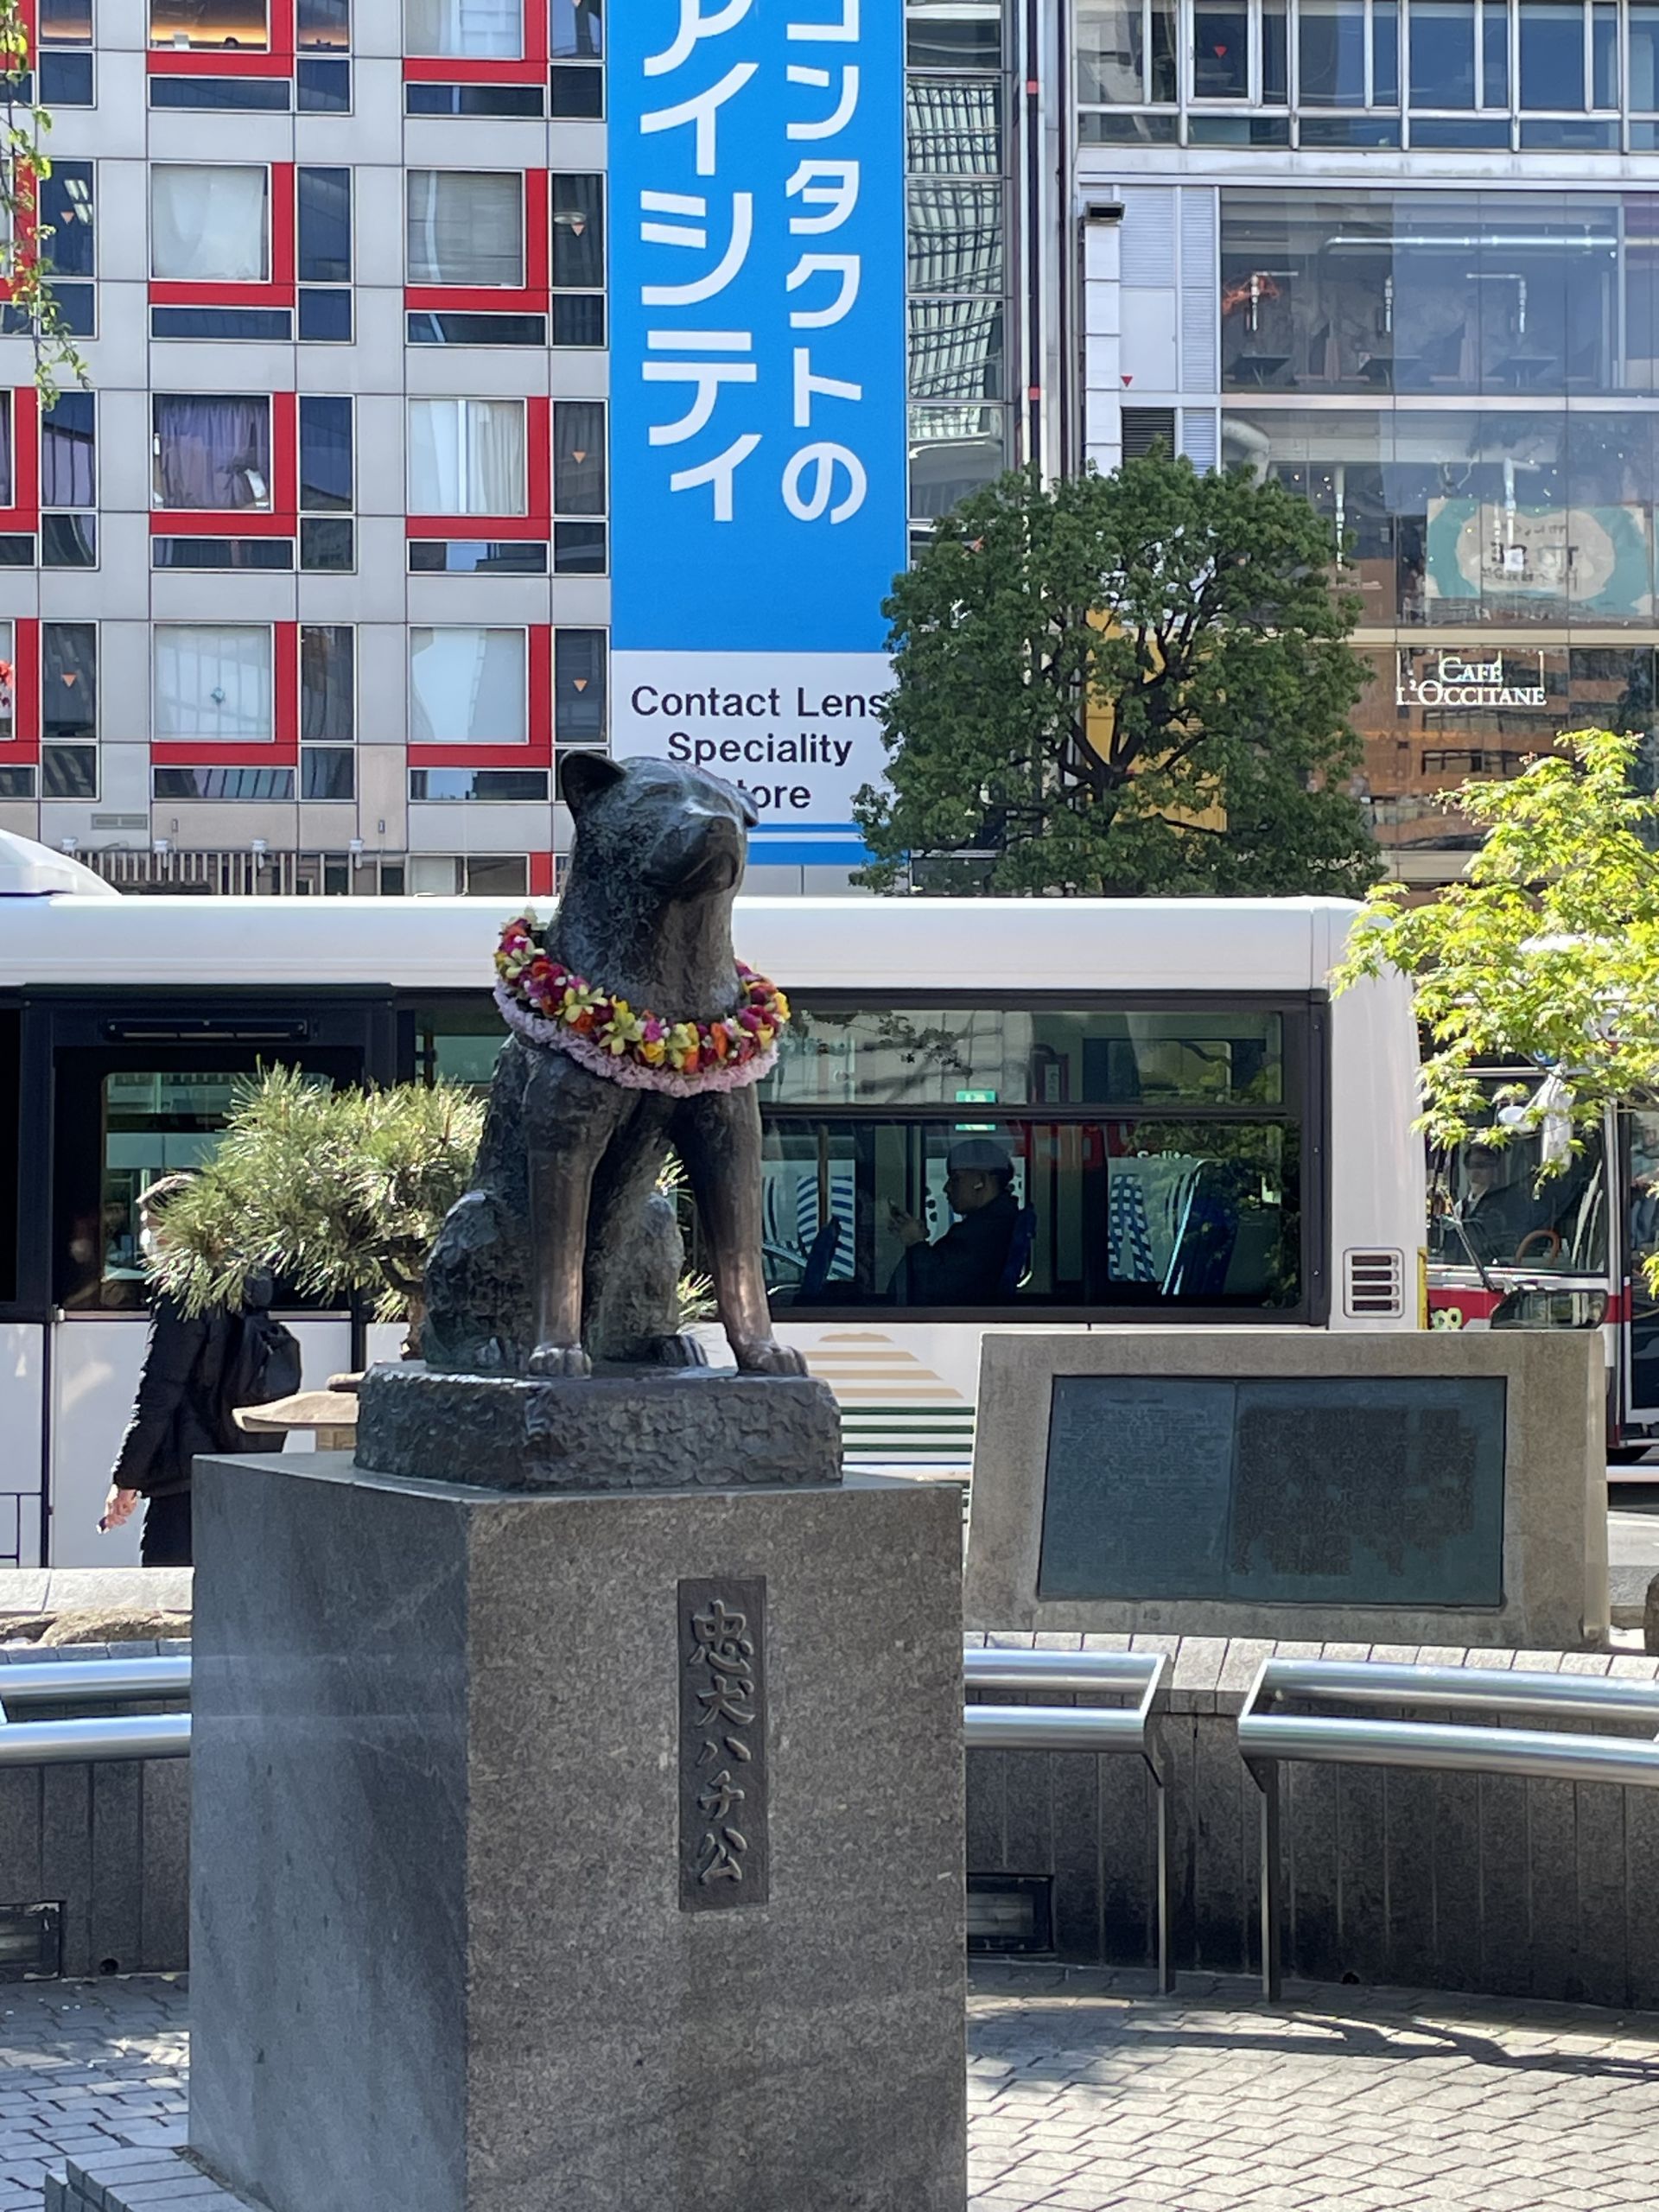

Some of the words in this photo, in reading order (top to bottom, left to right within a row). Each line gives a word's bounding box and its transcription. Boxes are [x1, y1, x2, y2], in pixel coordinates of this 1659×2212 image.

[782, 0, 867, 524] コンタクトの
[632, 685, 781, 716] Contact
[798, 687, 886, 717] Lens
[668, 732, 853, 766] Speciality
[737, 779, 811, 809] ore
[690, 1599, 755, 1886] 忠犬ハチ公
